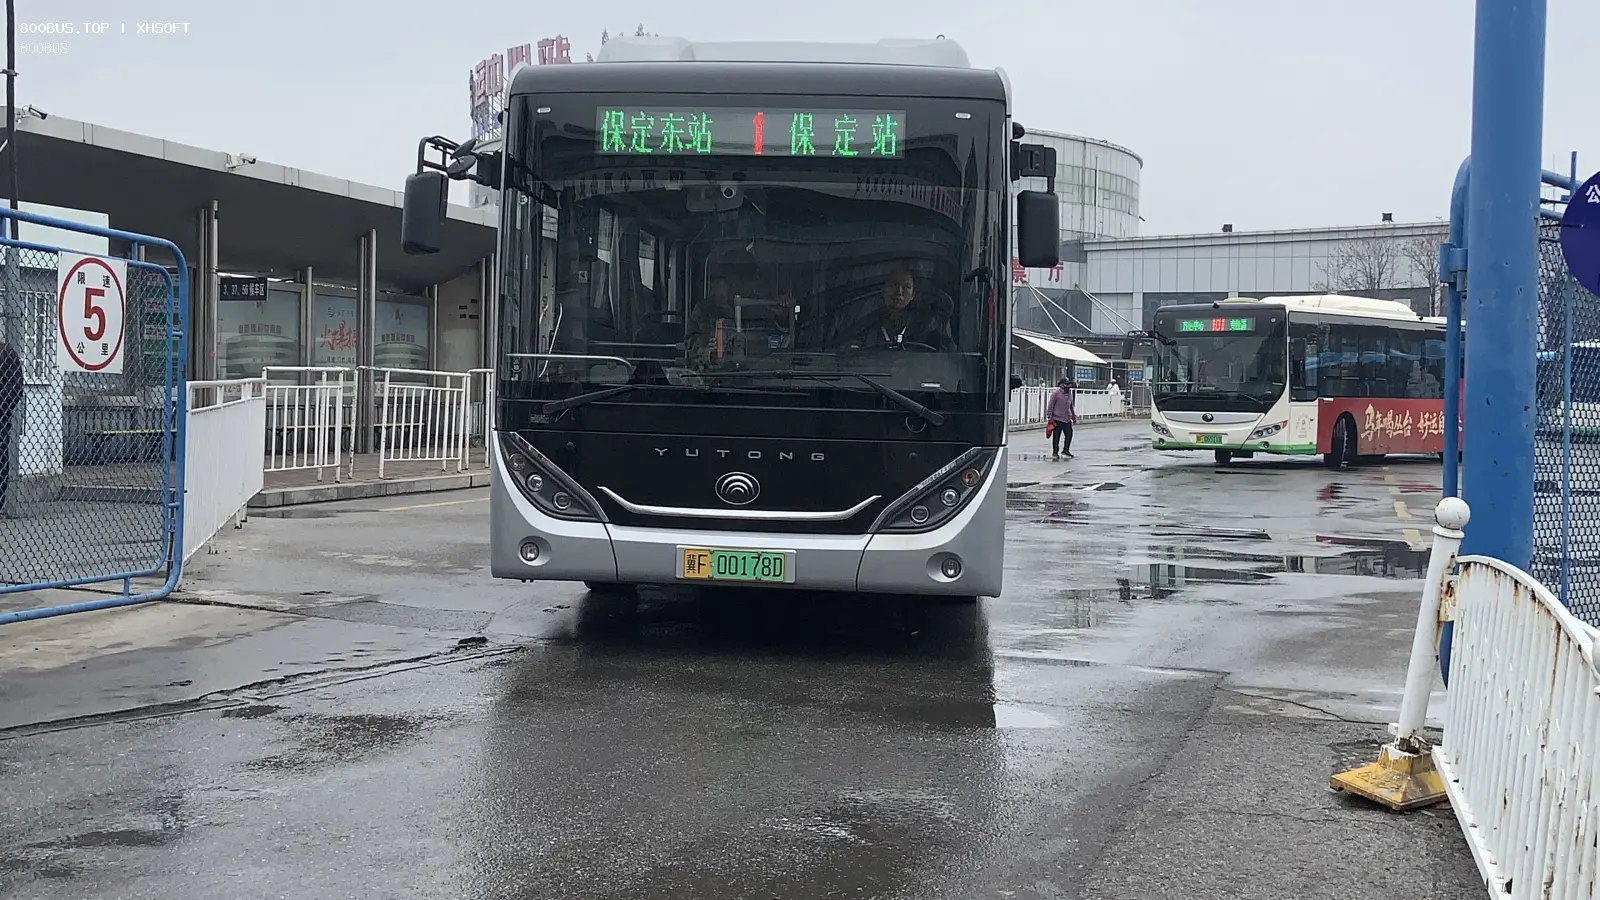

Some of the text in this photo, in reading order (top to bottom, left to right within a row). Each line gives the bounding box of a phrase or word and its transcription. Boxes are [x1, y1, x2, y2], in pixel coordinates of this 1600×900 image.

[600, 110, 713, 153] 保定东站
[752, 112, 764, 155] 1
[83, 287, 106, 341] 5
[1212, 318, 1226, 332] 101
[654, 447, 826, 461] YUTONG
